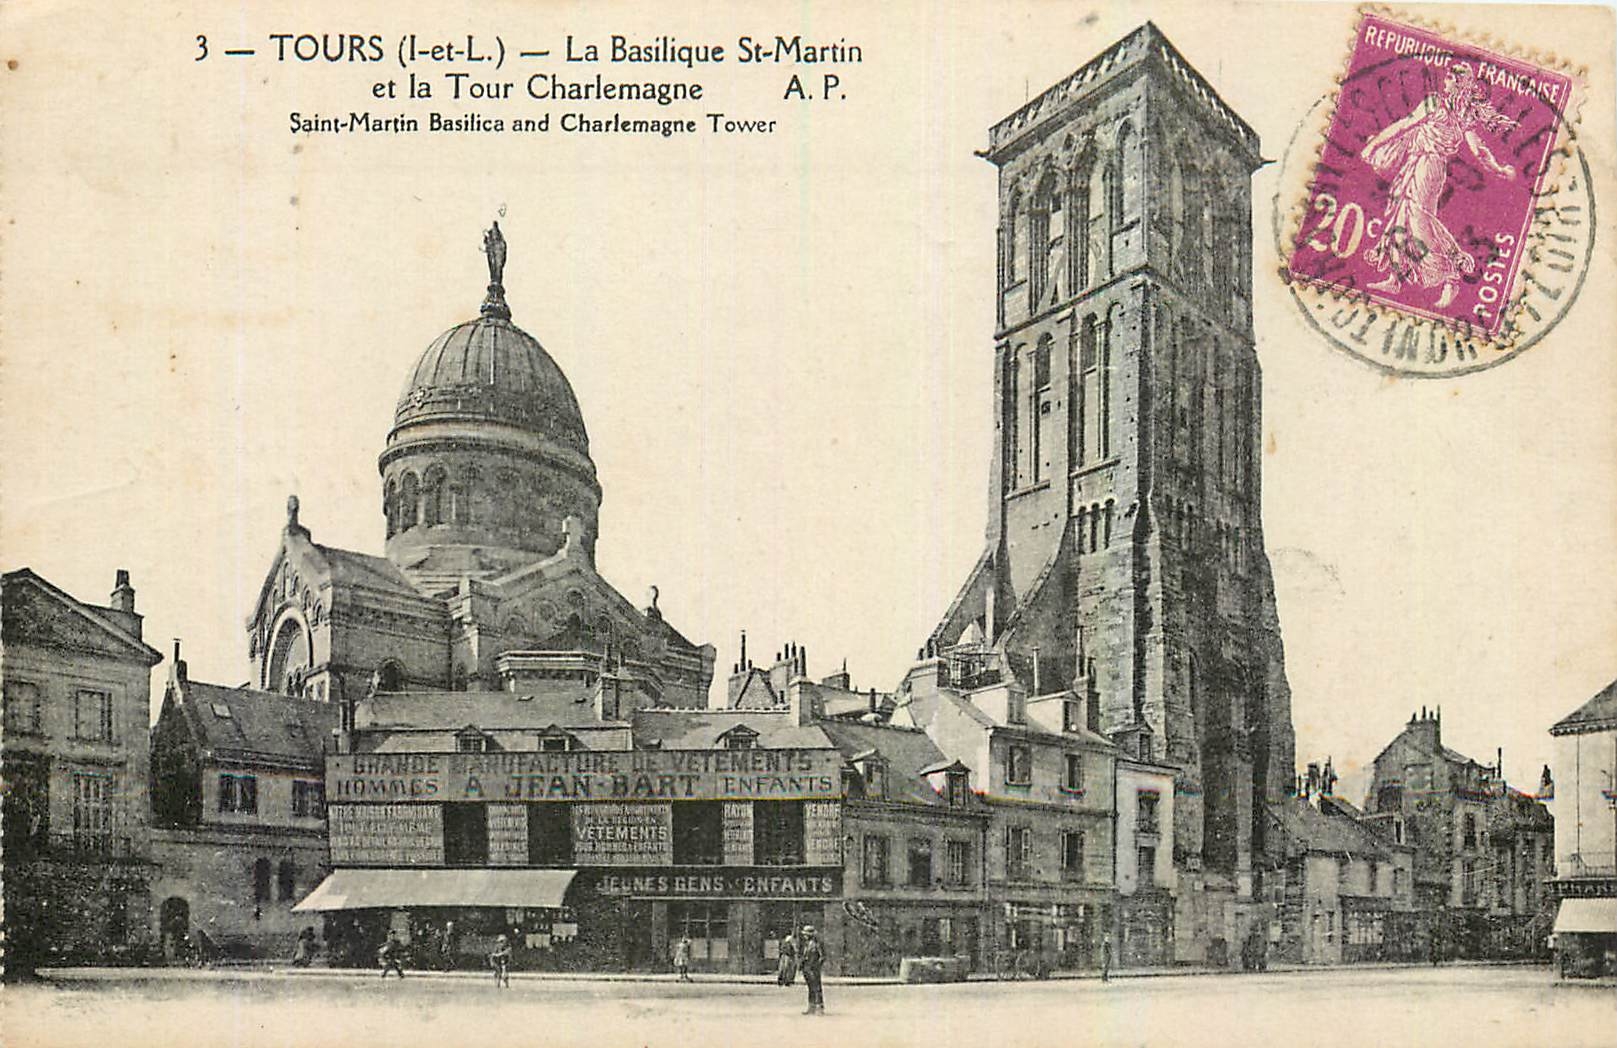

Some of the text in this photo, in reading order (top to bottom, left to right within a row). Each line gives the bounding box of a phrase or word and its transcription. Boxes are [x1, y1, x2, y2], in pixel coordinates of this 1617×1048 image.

[1472, 232, 1516, 319] POSTES
[336, 778, 439, 796] HOMMES
[464, 775, 485, 798] A
[719, 775, 833, 794] ENFANTS
[575, 825, 669, 841] VETEMENTS
[744, 876, 833, 893] ENFANTS
